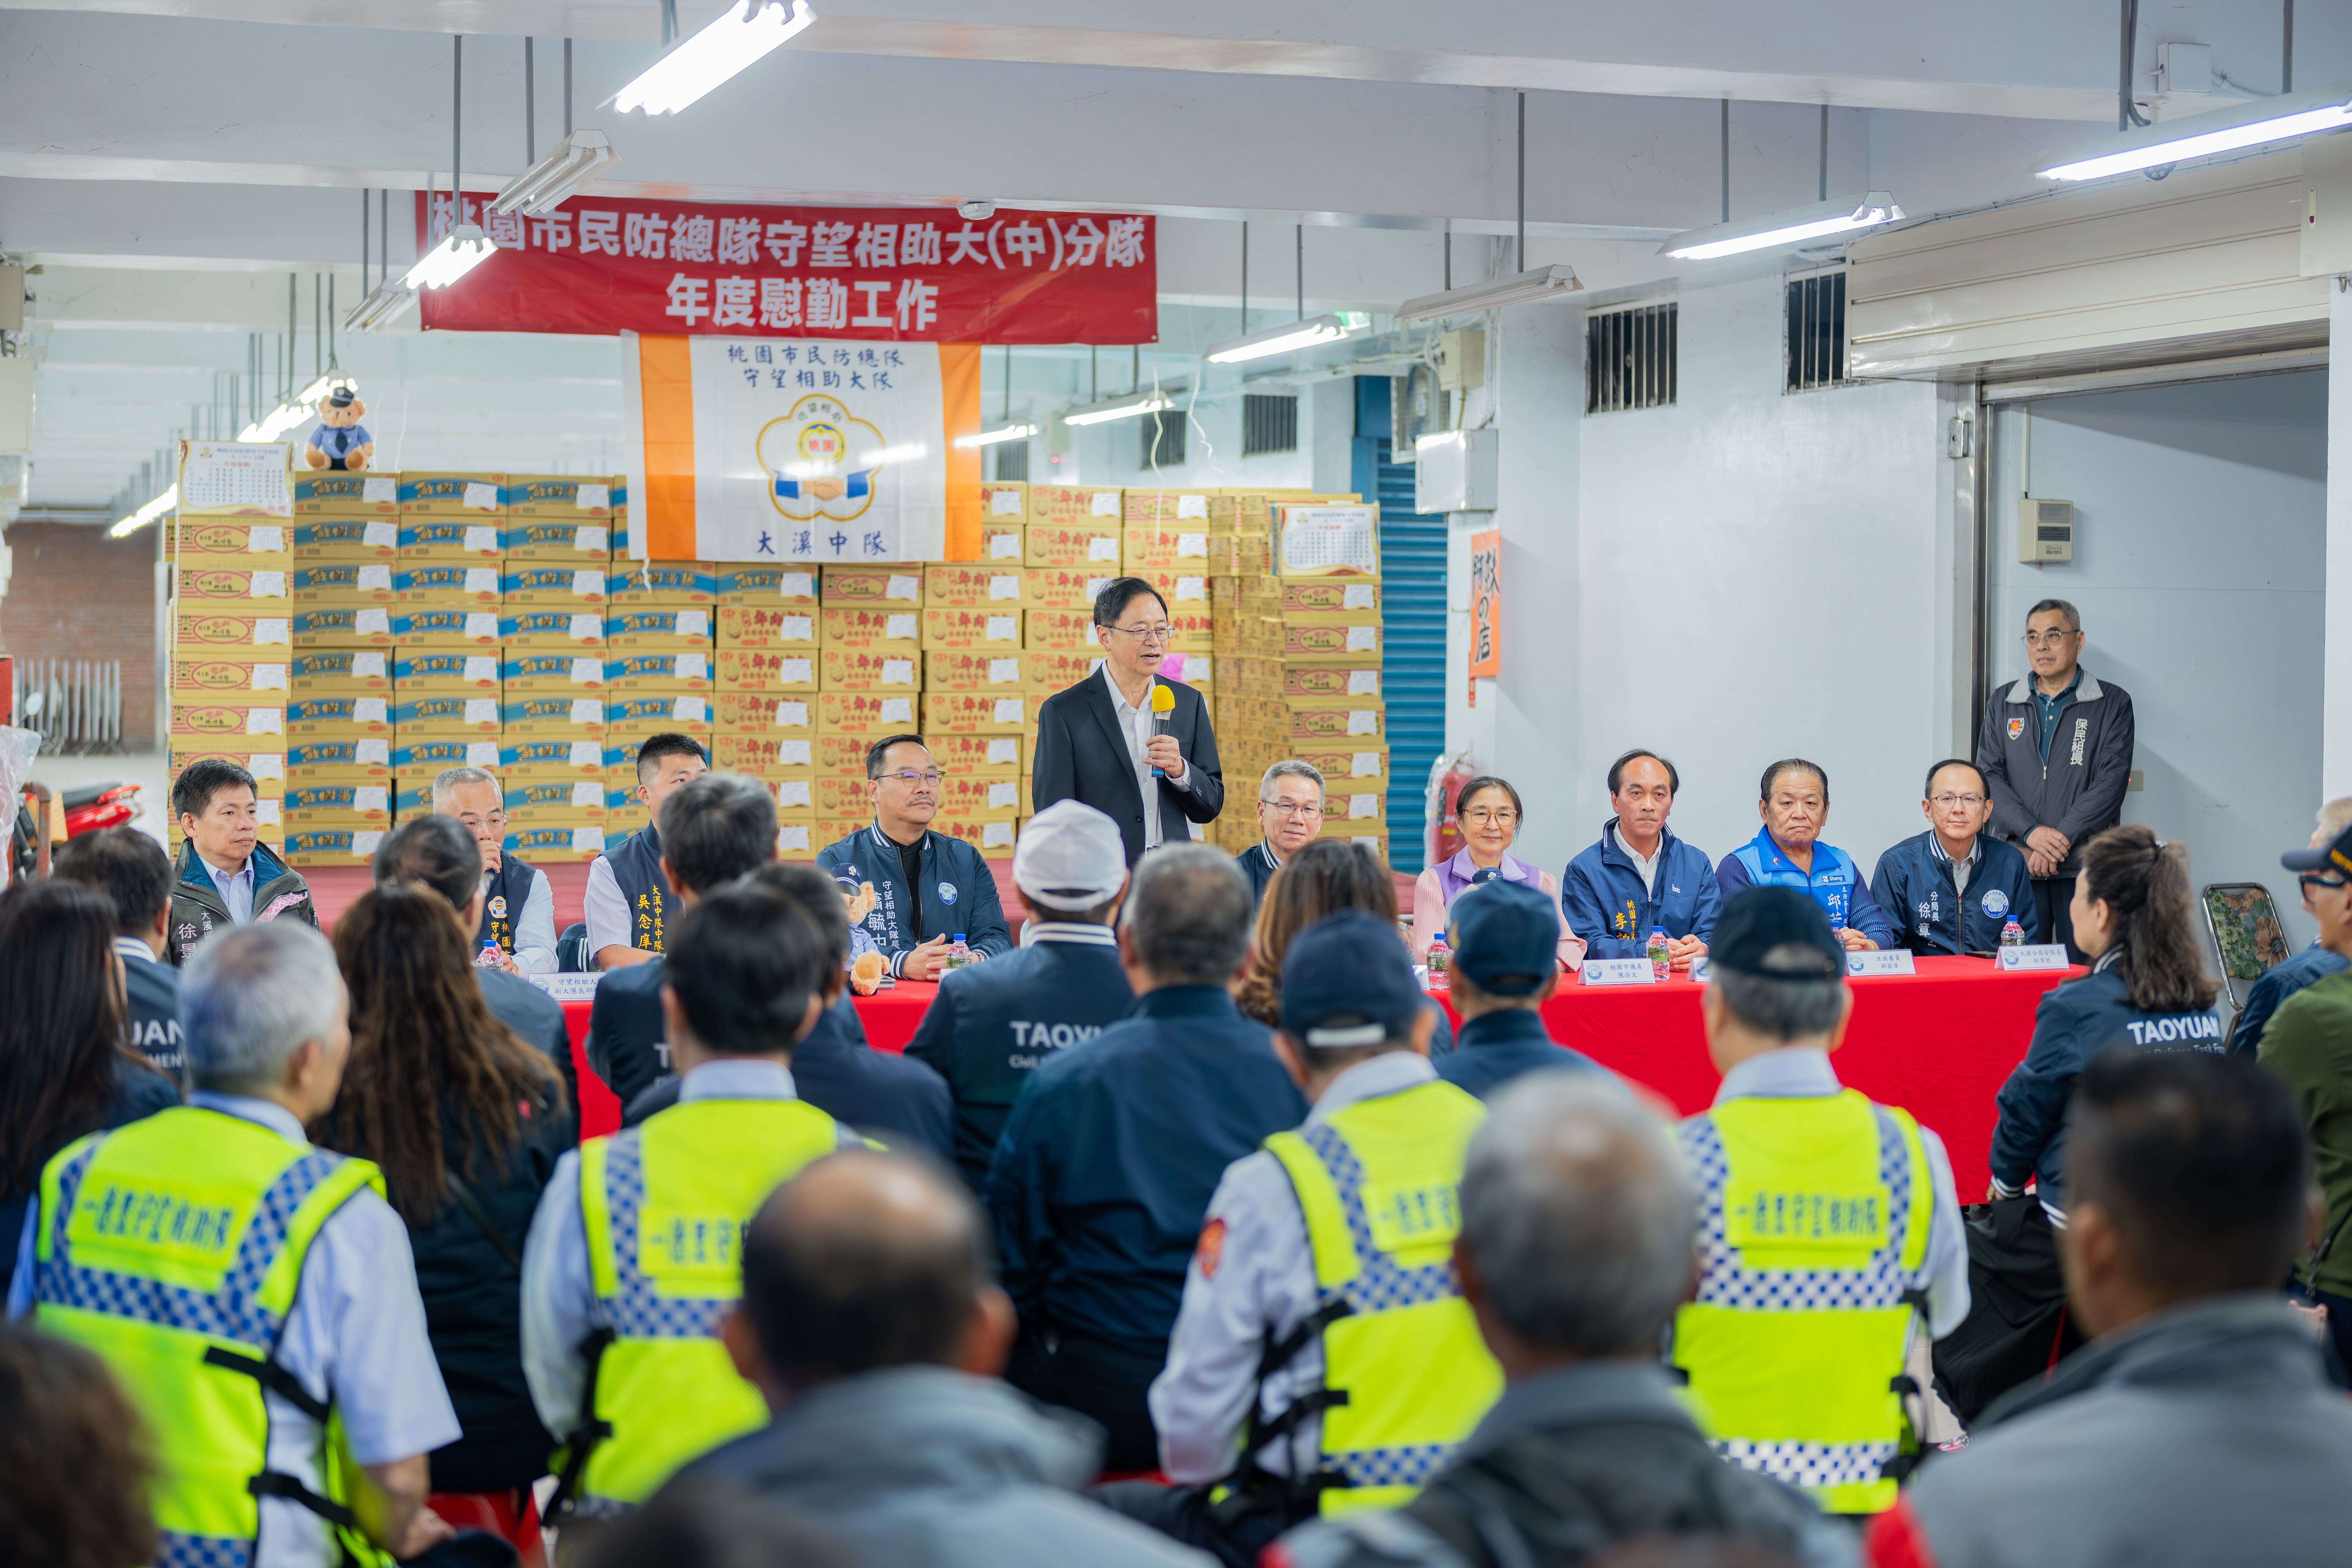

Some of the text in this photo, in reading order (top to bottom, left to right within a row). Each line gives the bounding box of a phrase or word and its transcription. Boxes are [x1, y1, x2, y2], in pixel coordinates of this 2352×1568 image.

[666, 273, 938, 331] 年度慰勤工作
[728, 345, 905, 368] 桃園市民防總隊
[743, 368, 893, 390] 守望相助大隊
[757, 530, 887, 555] 大溪中隊
[2070, 718, 2088, 766] 保民組長
[652, 885, 664, 953] 大溪中隊中隊
[882, 881, 900, 949] 守望相助大隊長
[1931, 891, 1939, 922] 分局長
[1009, 1021, 1102, 1049] TAOY
